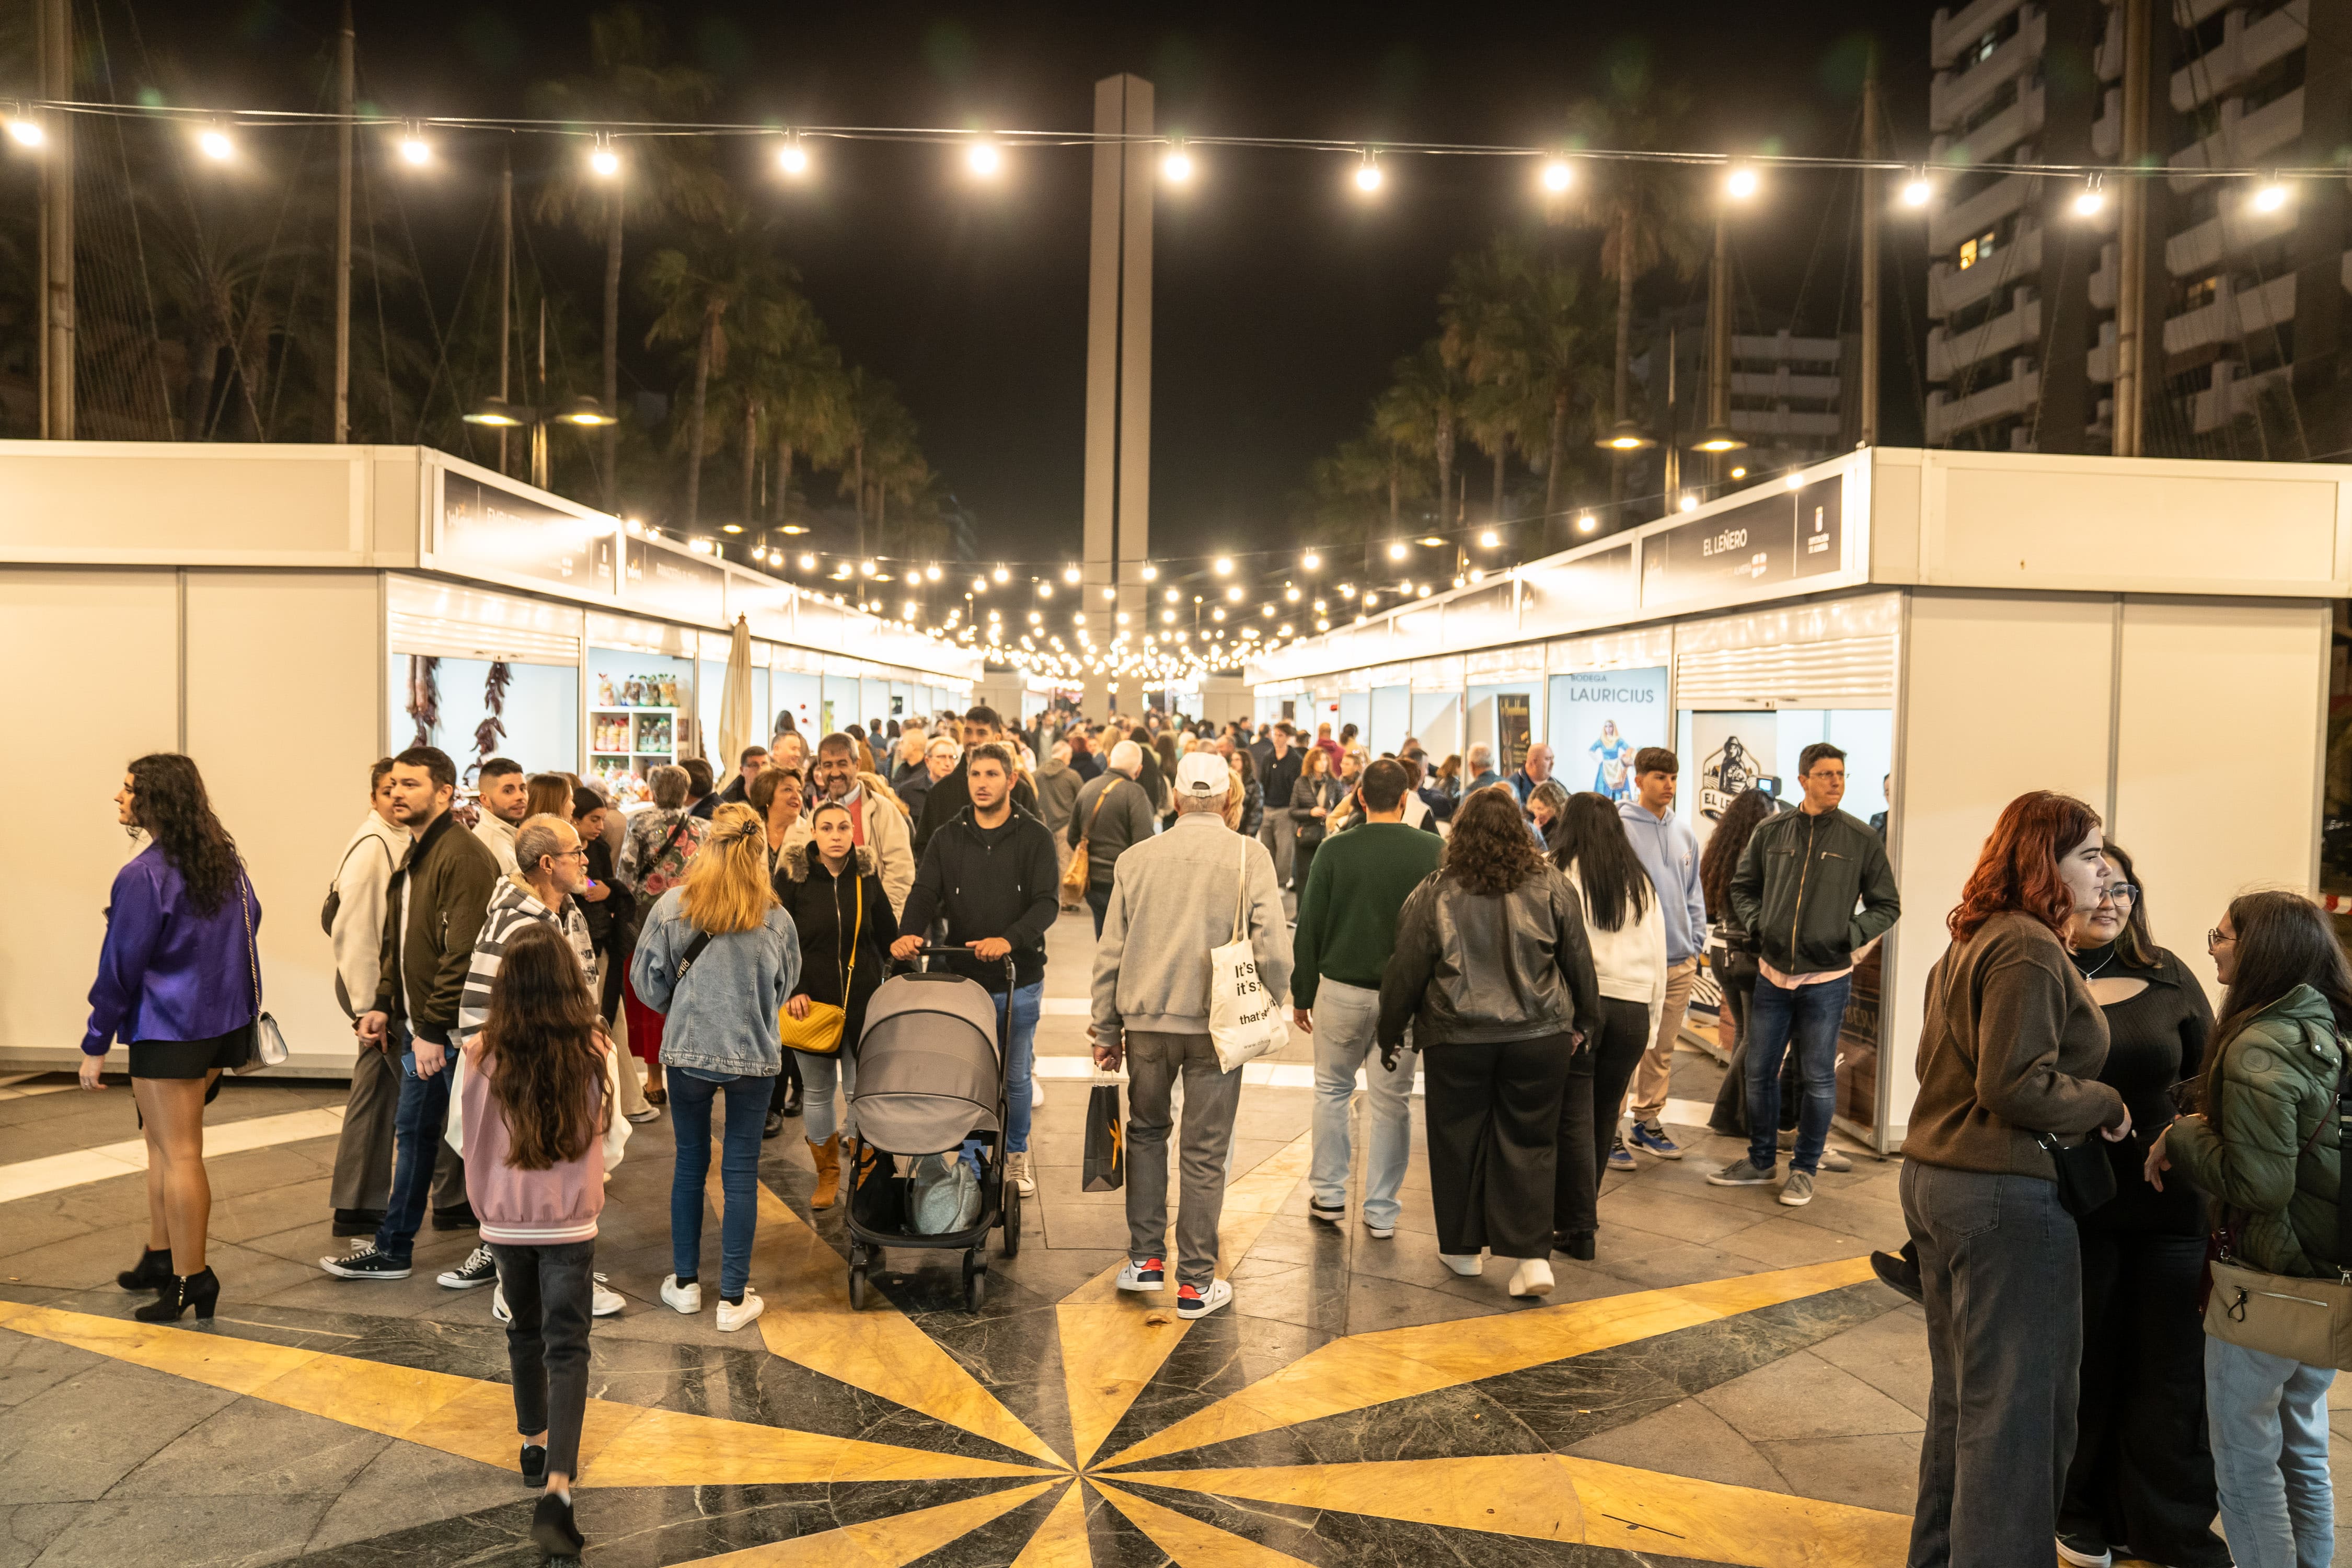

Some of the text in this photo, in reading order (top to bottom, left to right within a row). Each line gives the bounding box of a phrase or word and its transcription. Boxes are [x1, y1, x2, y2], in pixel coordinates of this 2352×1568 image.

[1703, 528, 1748, 556] EL LEÑERO
[1571, 674, 1607, 682] BODEGA
[1571, 687, 1654, 704] LAURICIUS
[1704, 793, 1716, 805] EL
[1235, 962, 1254, 978] It's
[1237, 981, 1256, 996] it's
